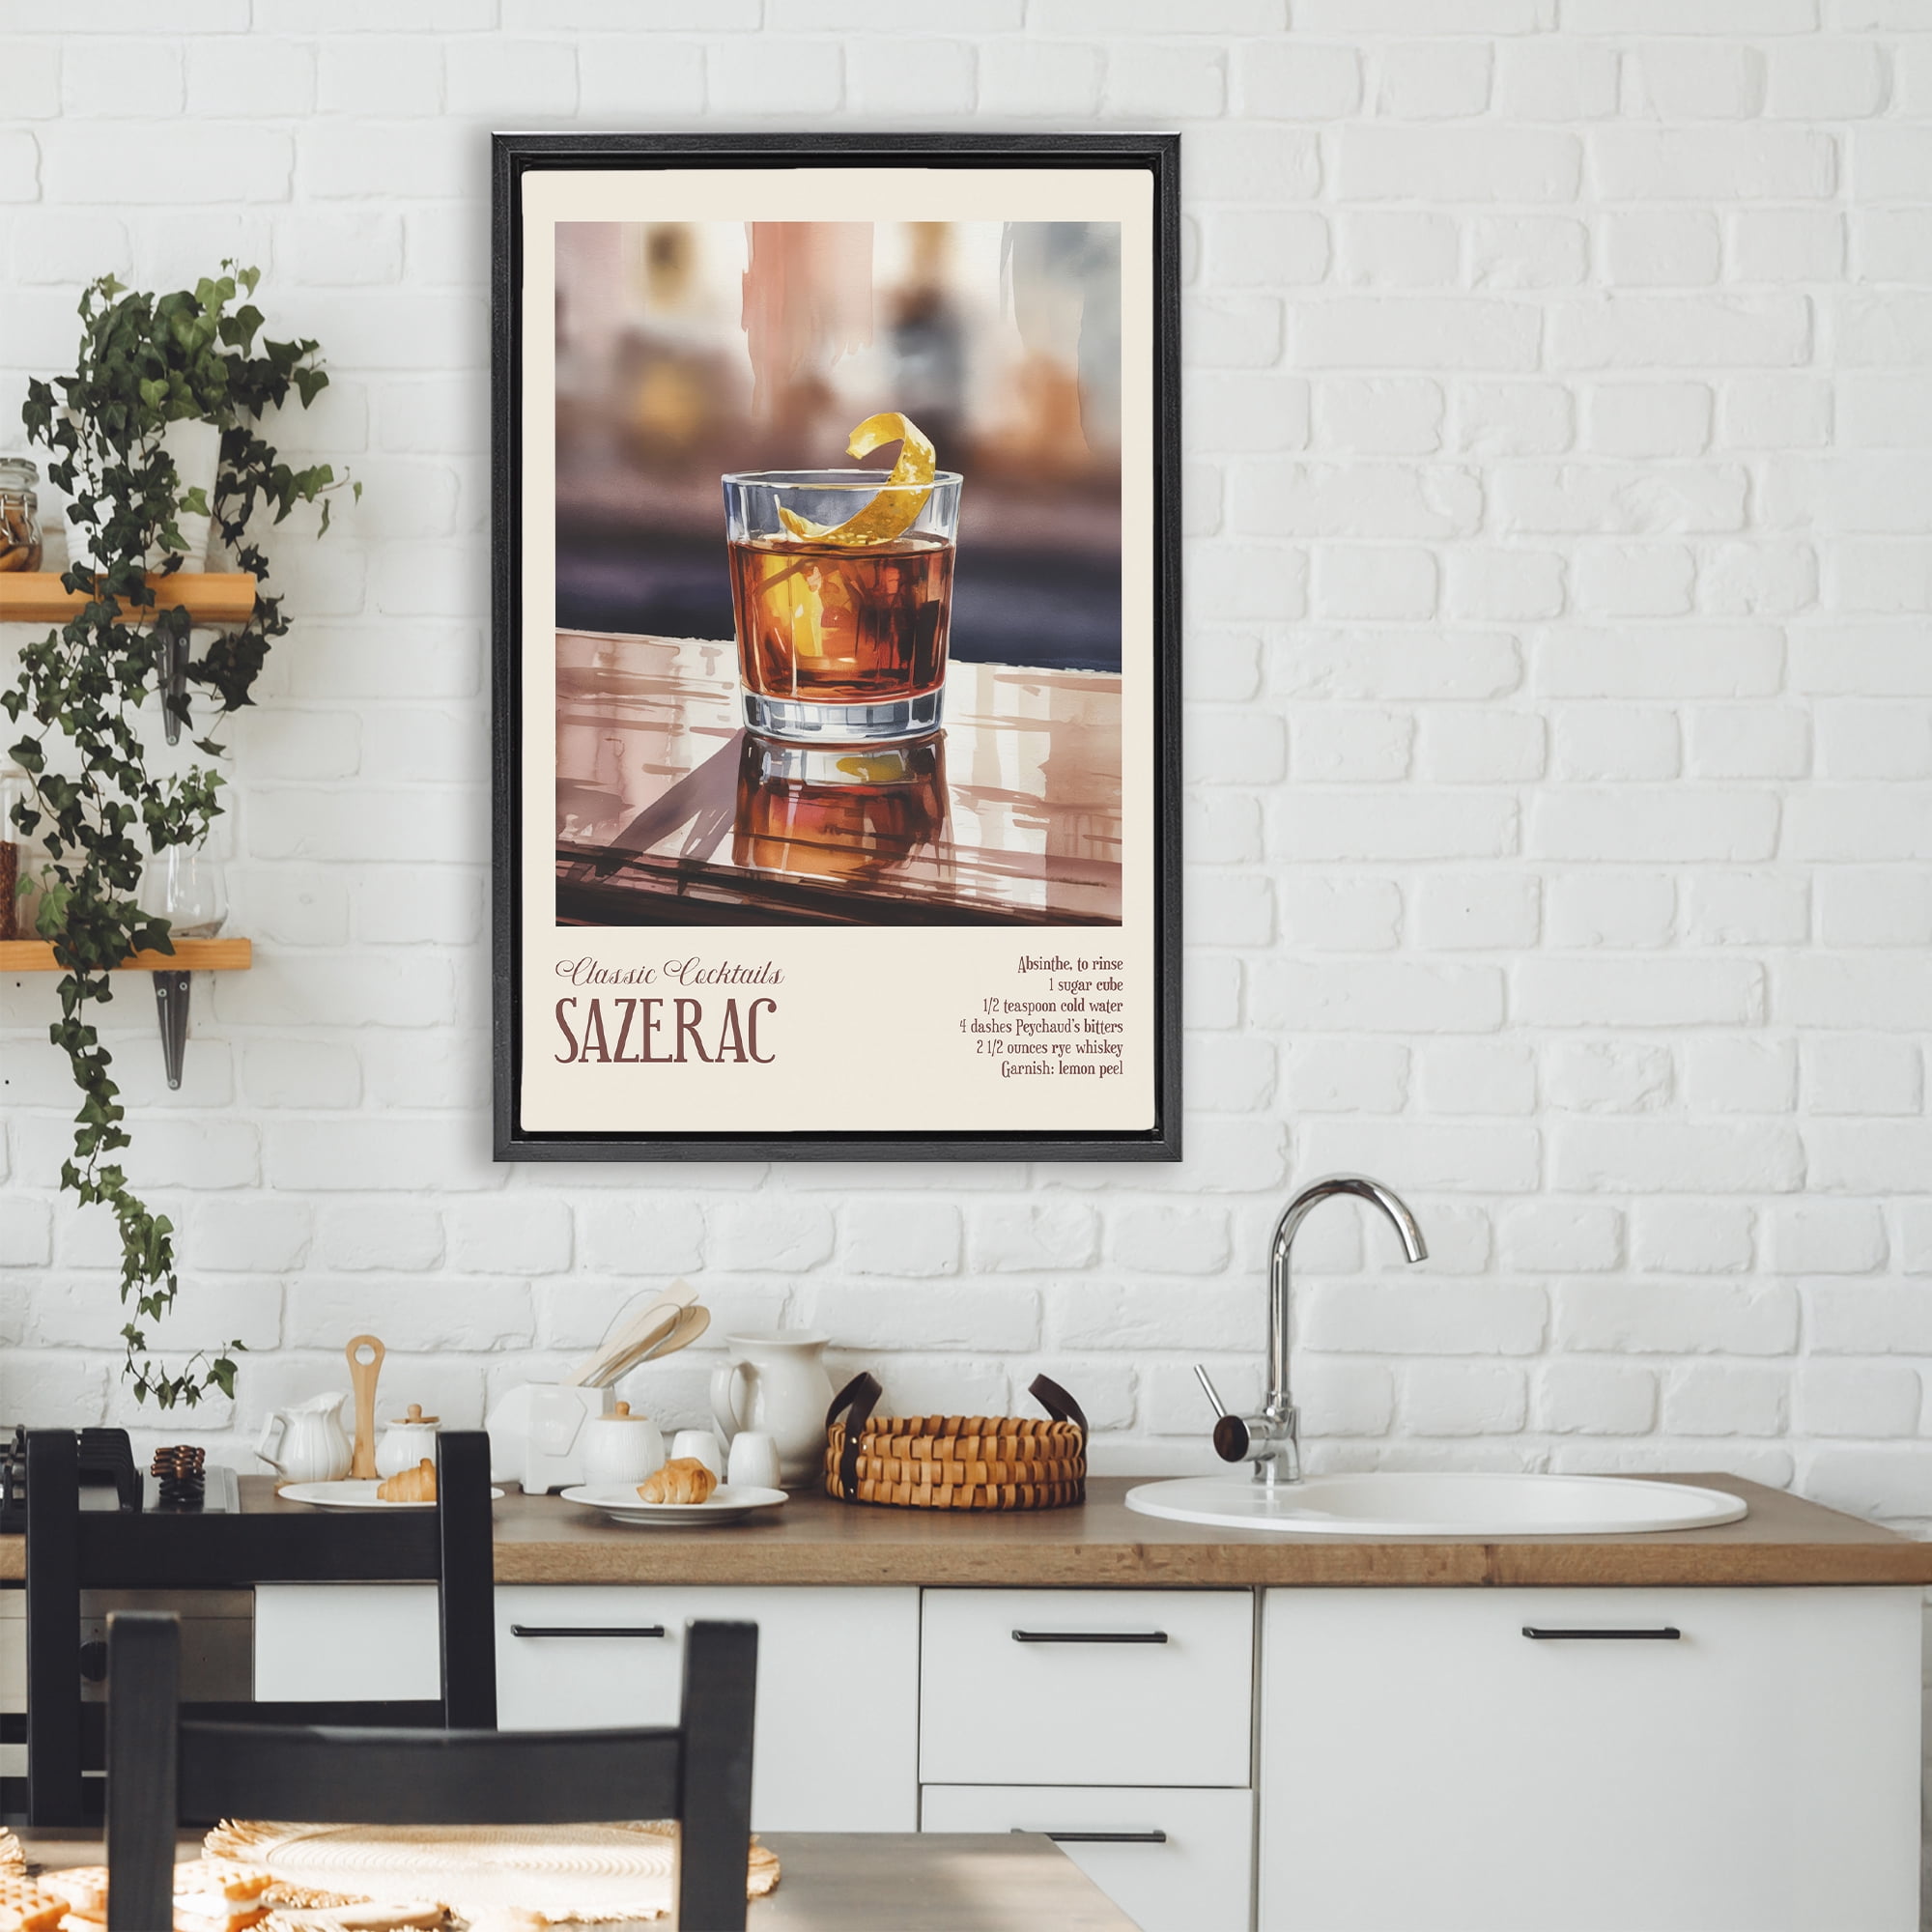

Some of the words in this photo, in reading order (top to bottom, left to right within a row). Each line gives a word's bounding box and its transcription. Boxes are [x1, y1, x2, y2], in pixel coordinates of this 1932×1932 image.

[555, 957, 657, 985] Classic
[664, 957, 784, 985] Cocktails
[1017, 955, 1073, 973] Absinthe,
[1077, 957, 1088, 972] to
[1092, 956, 1123, 970] rinse
[1049, 978, 1053, 991] 1
[1058, 980, 1092, 995] sugar
[1096, 977, 1123, 991] cube
[983, 997, 999, 1014] 1/2
[1003, 1000, 1056, 1015] teaspoon
[1061, 998, 1085, 1012] cold
[1089, 999, 1123, 1013] water
[554, 997, 777, 1064] SAZERAC
[959, 1019, 967, 1033] 4
[971, 1018, 1011, 1033] dashes
[1084, 1018, 1123, 1035] bitters
[977, 1039, 982, 1054] 2
[987, 1039, 1003, 1057] 1/2
[1008, 1044, 1047, 1054] ounces
[1052, 1044, 1071, 1058] rye
[1076, 1039, 1123, 1058] whiskey
[1002, 1061, 1054, 1078] Garnish:
[1059, 1061, 1095, 1074] lemon
[1099, 1061, 1123, 1078] peel
